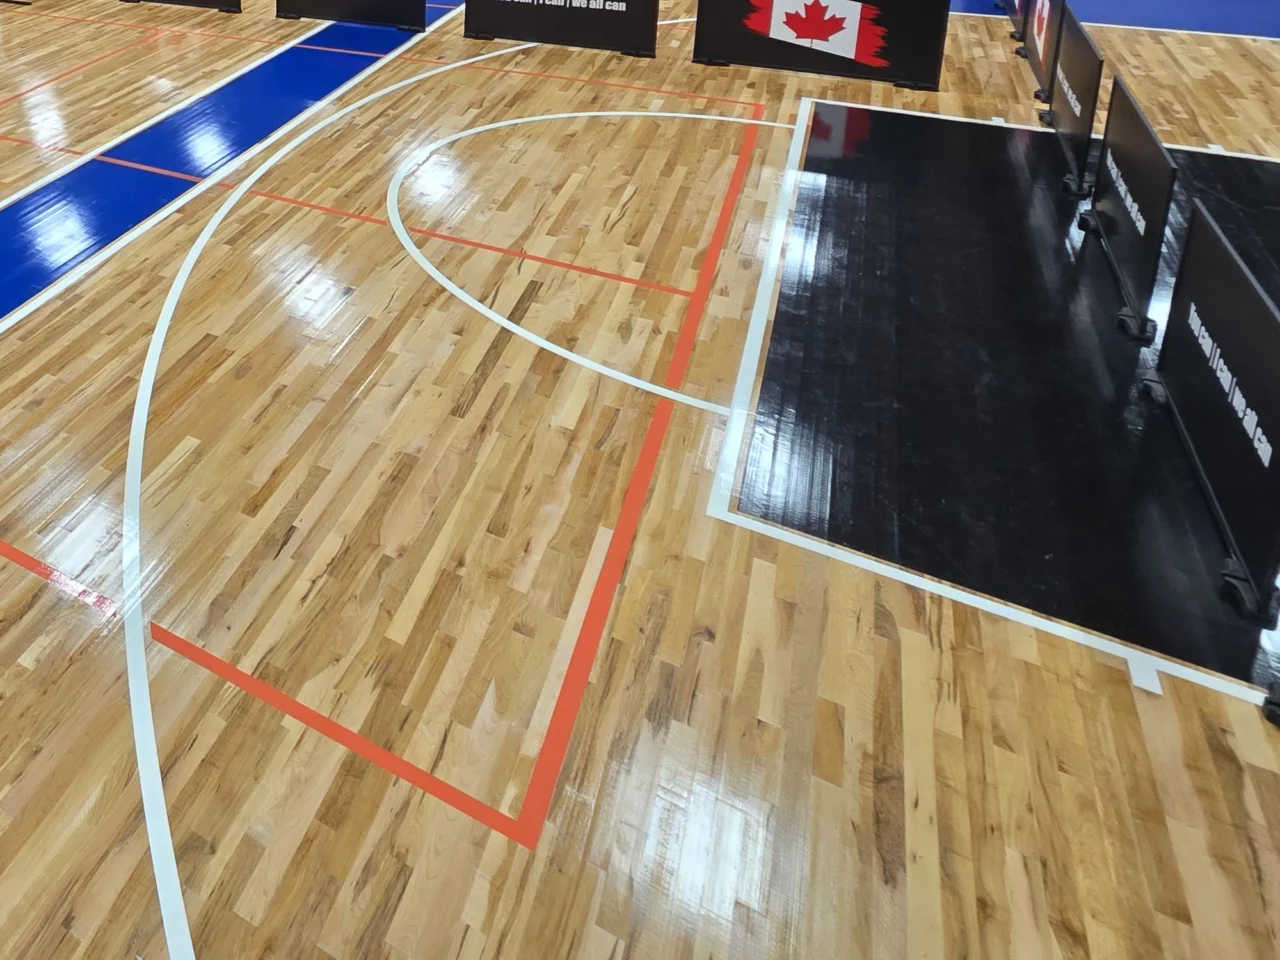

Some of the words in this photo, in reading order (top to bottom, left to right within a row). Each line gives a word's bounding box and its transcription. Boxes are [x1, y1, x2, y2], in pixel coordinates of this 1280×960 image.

[605, 1, 626, 11] can
[1188, 302, 1202, 337] You
[1198, 325, 1213, 358] can
[1216, 358, 1232, 393] can
[1232, 386, 1246, 418] we
[1243, 407, 1258, 439] all
[1253, 426, 1273, 467] can
